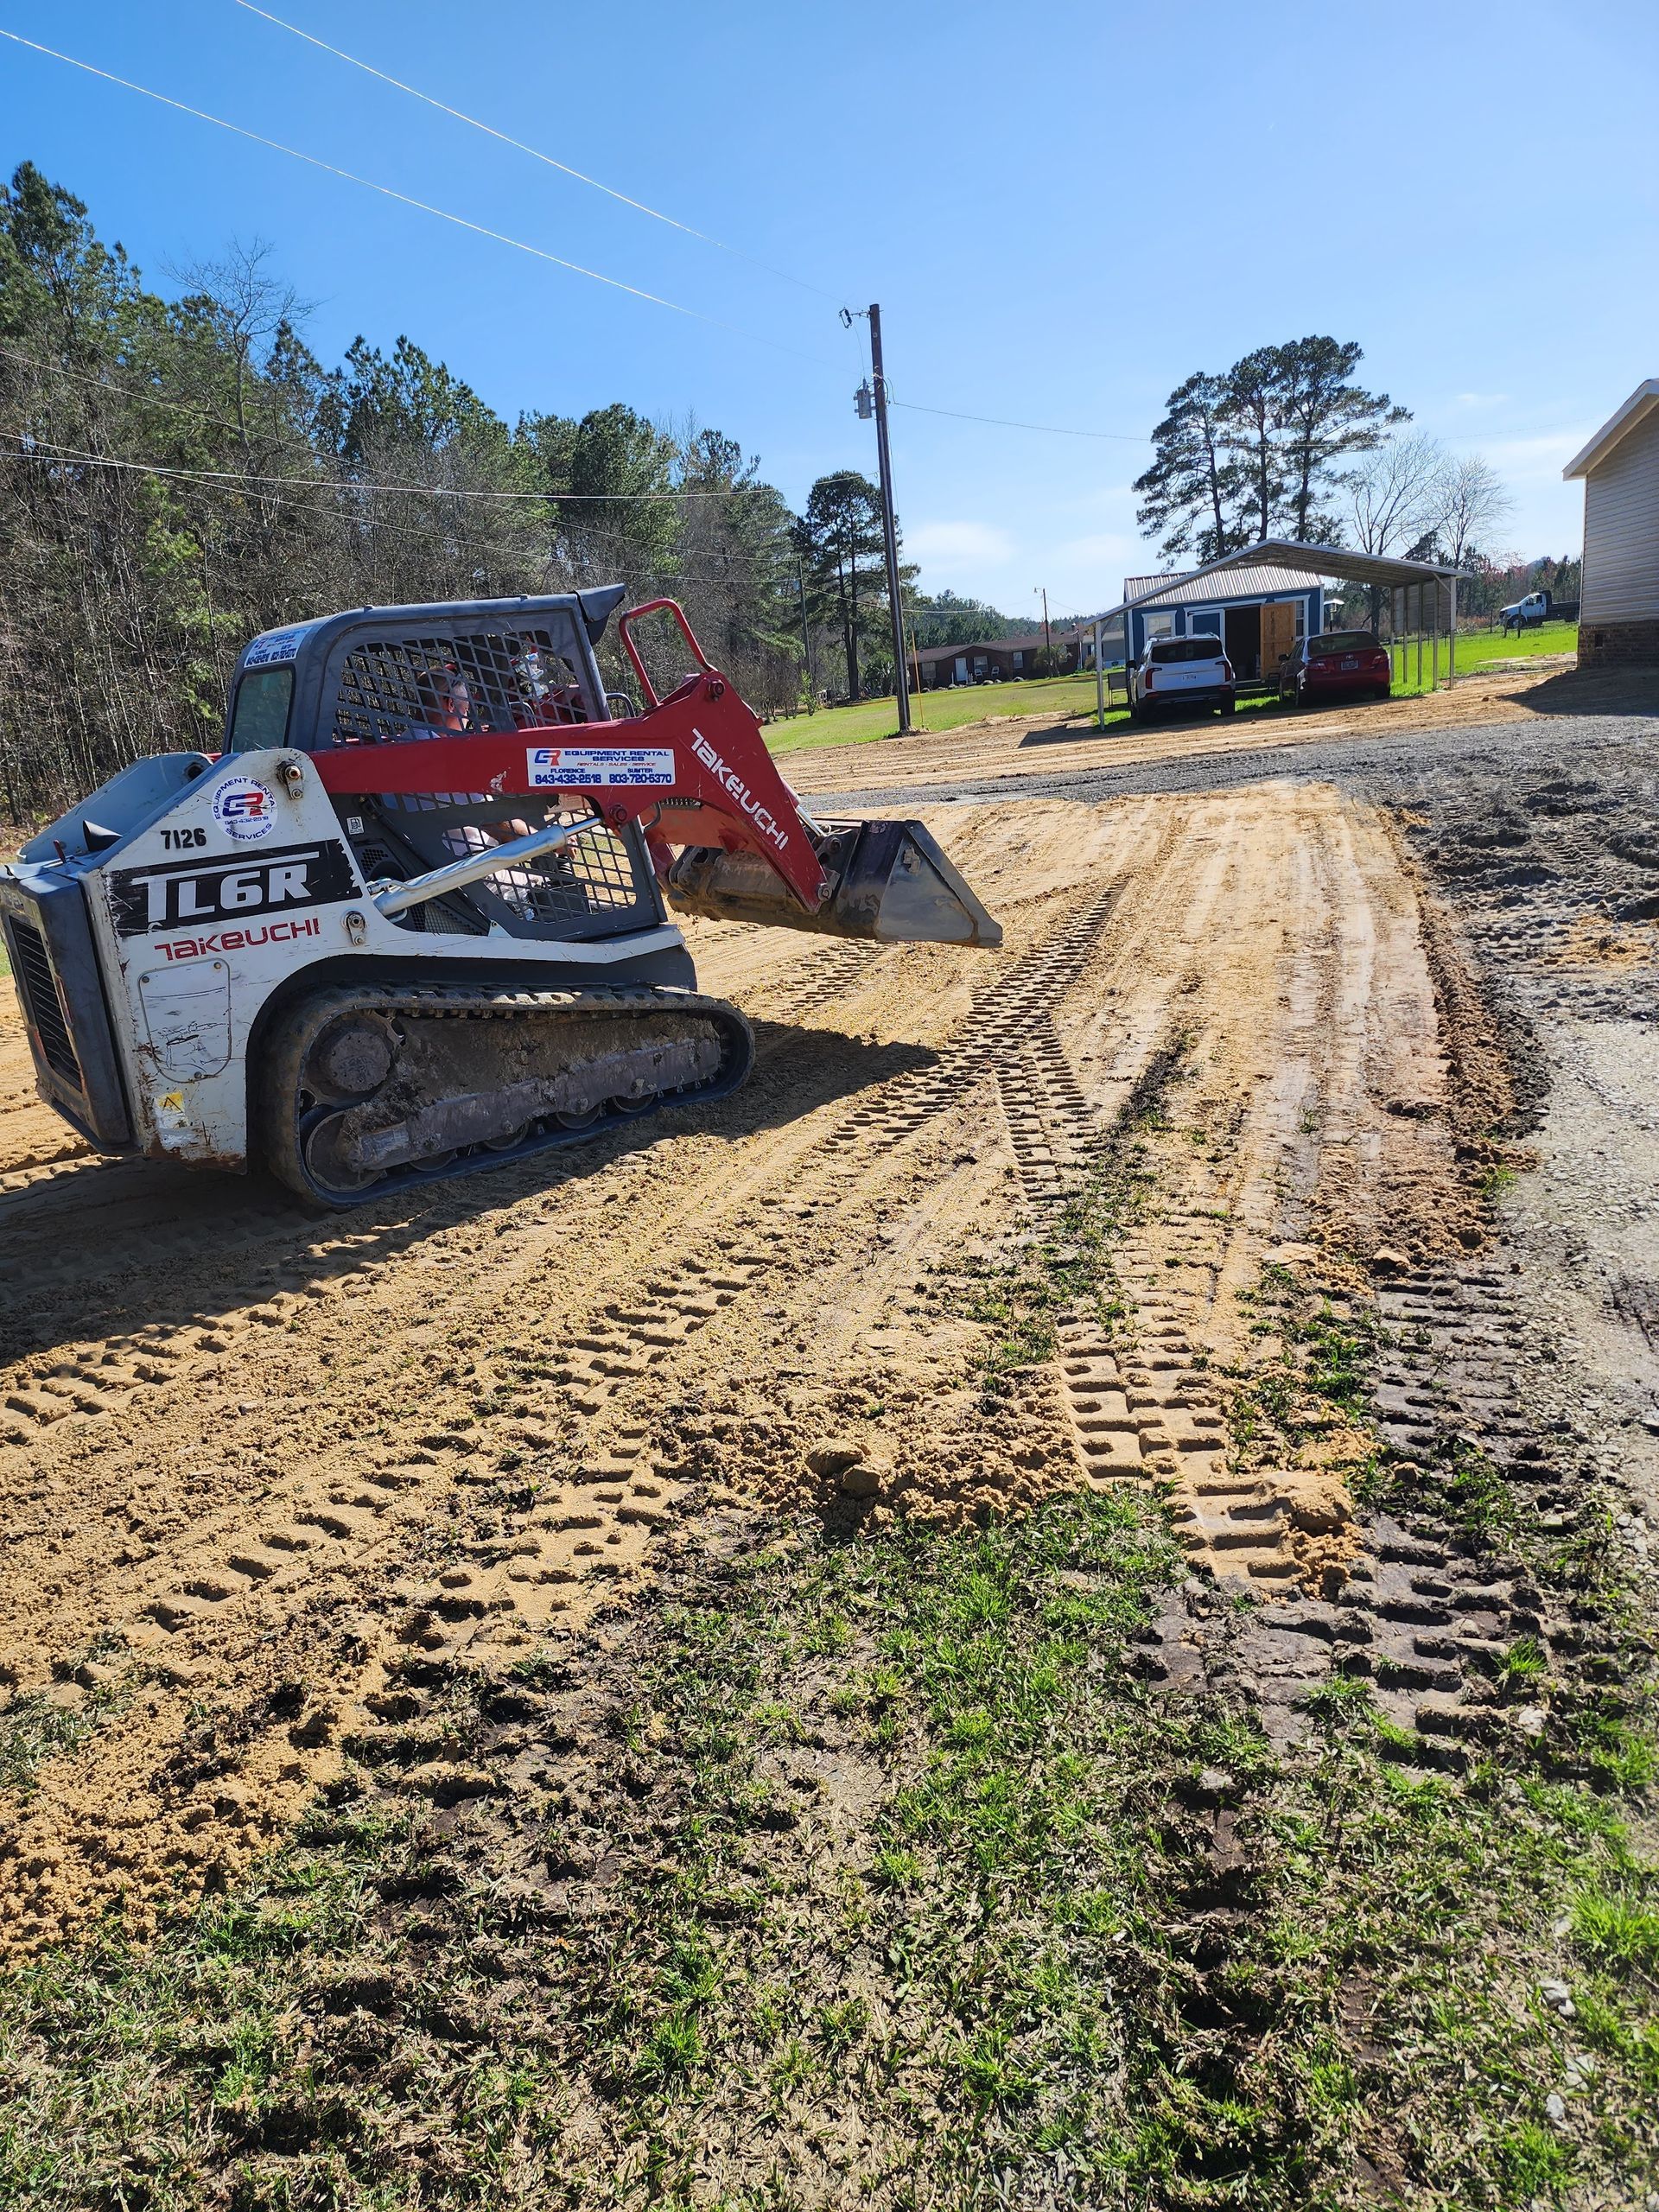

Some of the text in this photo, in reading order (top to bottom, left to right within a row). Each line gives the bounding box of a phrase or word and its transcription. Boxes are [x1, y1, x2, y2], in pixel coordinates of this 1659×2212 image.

[535, 773, 602, 785] 843-432-2518
[609, 773, 672, 784] 803-720-5370
[213, 778, 248, 820] EQUIPMENT
[160, 827, 207, 850] 7126
[225, 823, 272, 840] SERVICES
[131, 851, 320, 924] TL6R
